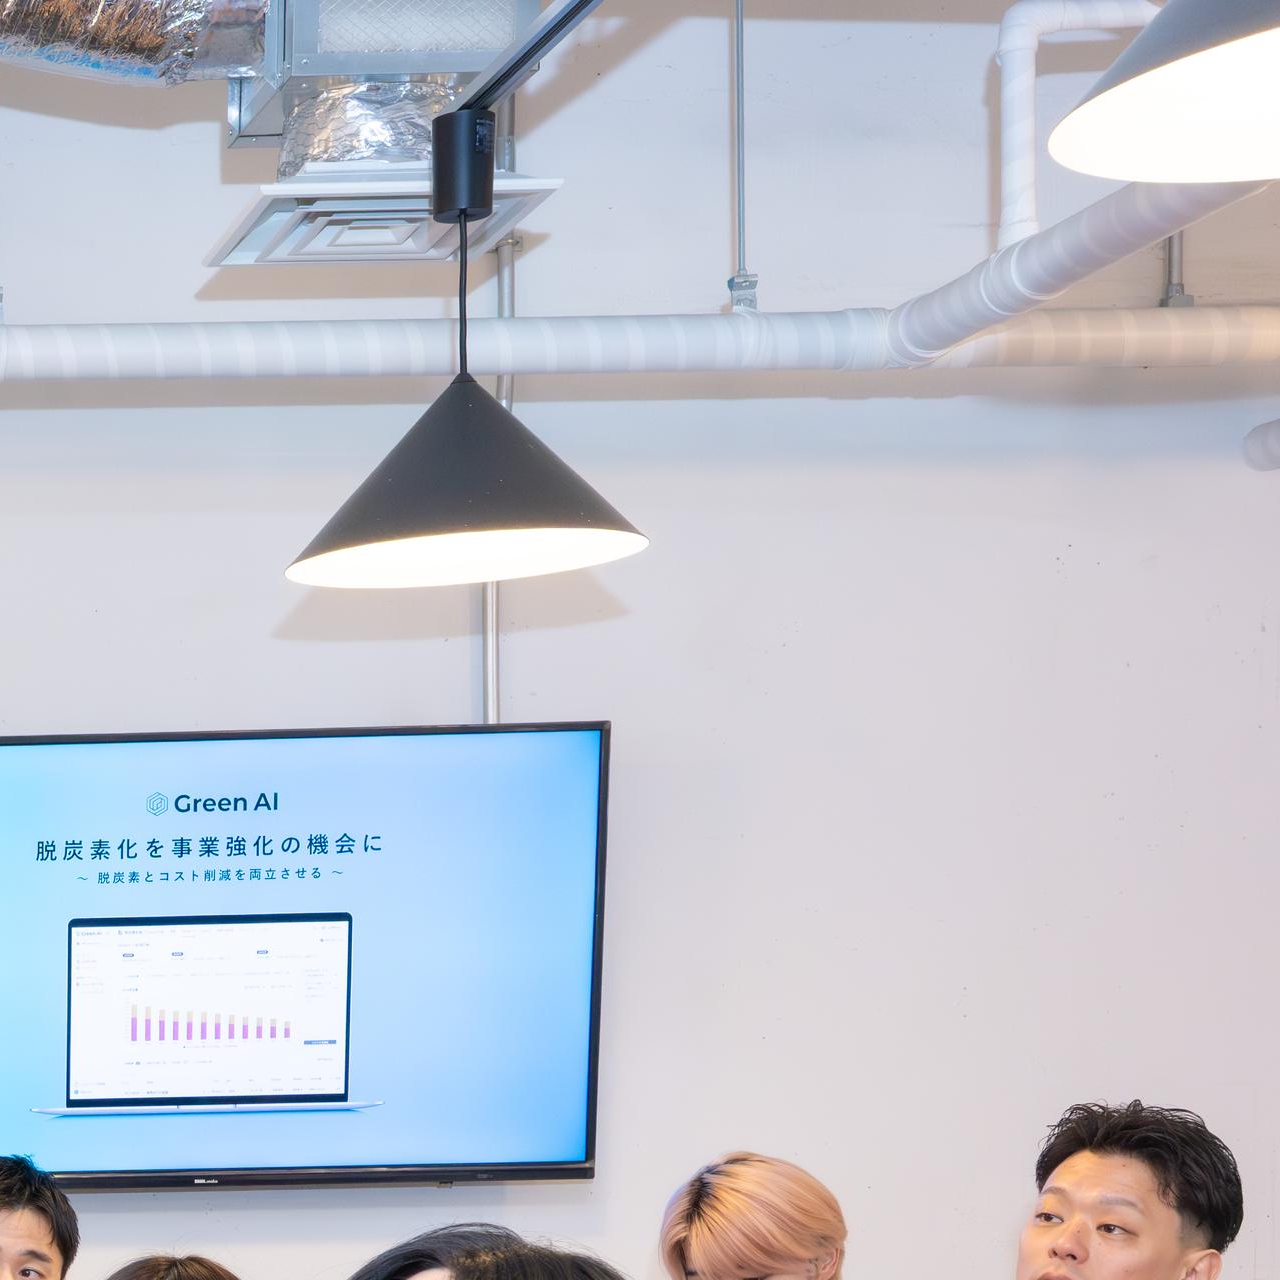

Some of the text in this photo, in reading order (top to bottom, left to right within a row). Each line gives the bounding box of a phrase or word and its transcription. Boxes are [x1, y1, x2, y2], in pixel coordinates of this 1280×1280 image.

[174, 791, 279, 813] Green AI
[35, 832, 383, 862] 脱炭素化を事業強化の機会に
[97, 867, 322, 884] 脱炭素とコスト削減を両立させる
